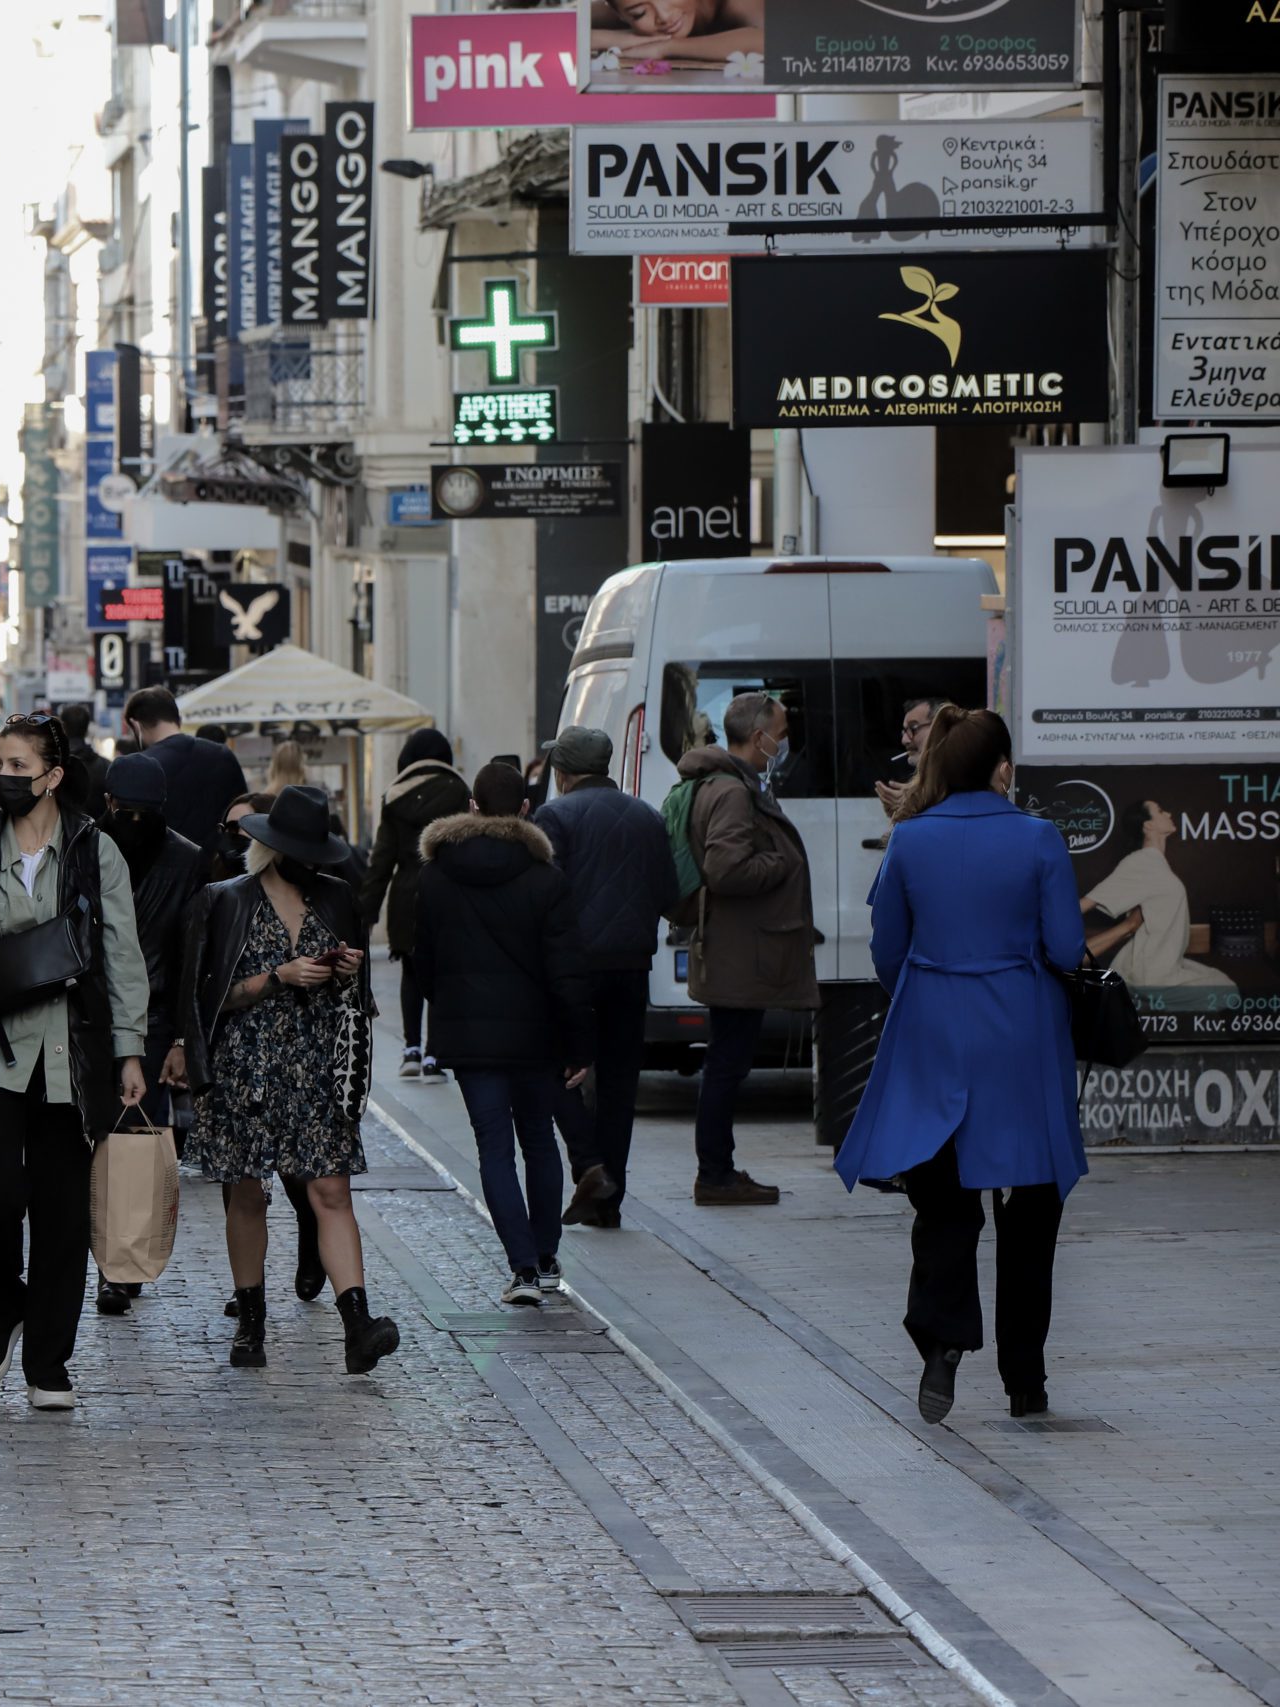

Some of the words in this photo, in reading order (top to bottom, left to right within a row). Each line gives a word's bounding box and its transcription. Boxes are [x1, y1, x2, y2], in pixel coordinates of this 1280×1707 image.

[816, 35, 876, 54] Ερμού
[881, 36, 899, 51] 16
[940, 35, 951, 51] 2
[424, 39, 551, 100] pink
[782, 57, 818, 75] Τηλ:
[822, 56, 911, 73] 2114187173
[926, 56, 959, 71] Κιν:
[962, 54, 1069, 71] 6936653059
[961, 136, 1036, 154] Κεντρικά
[961, 154, 1025, 172] Βουλής
[1028, 154, 1047, 169] 34
[961, 174, 1037, 192] pansik.gr
[240, 175, 256, 242] EAGLE
[335, 110, 367, 307] MANGO
[587, 203, 650, 219] SCUOLA
[653, 203, 668, 218] DI
[673, 203, 719, 218] MODA
[736, 203, 767, 217] ART
[771, 203, 784, 217] &
[788, 202, 843, 217] DESIGN
[961, 200, 1074, 215] 2103221001-2-3
[1202, 191, 1257, 211] Στον
[291, 143, 319, 320] MANGO
[1179, 221, 1280, 246] Υπέροχο
[1191, 251, 1267, 276] κόσμο
[267, 226, 281, 326] MERICAN
[240, 245, 256, 330] MERICAN
[1165, 285, 1205, 306] της
[1188, 356, 1267, 386] 3μηνα
[778, 372, 1064, 401] MEDICOSMETIC
[459, 393, 552, 421] APOTHEKE
[778, 403, 870, 417] ΑΔΥΝΑΤΙΣΜΑ
[884, 402, 958, 416] ΑΙΣΘΗΤΙΚΗ
[972, 400, 1062, 415] ΑΠΟΤΡΙΧΩΣΗ
[504, 466, 603, 481] ΓΝΩΡΙΜΙΕΣ
[544, 594, 593, 613] ΕΡΜ
[1054, 600, 1117, 615] SCUOLA
[1123, 600, 1137, 614] DI
[1143, 599, 1190, 614] MODA
[1208, 598, 1239, 612] ART
[1245, 598, 1258, 612] &
[1227, 651, 1262, 662] 1977
[1121, 711, 1133, 720] 34
[1051, 818, 1104, 831] SAGE
[1148, 993, 1166, 1010] 16
[1207, 993, 1217, 1009] 2
[1136, 1015, 1178, 1032] 7173
[1194, 1015, 1226, 1032] Κιν:
[1078, 1069, 1190, 1098] ΡΟΣΟΧΗ
